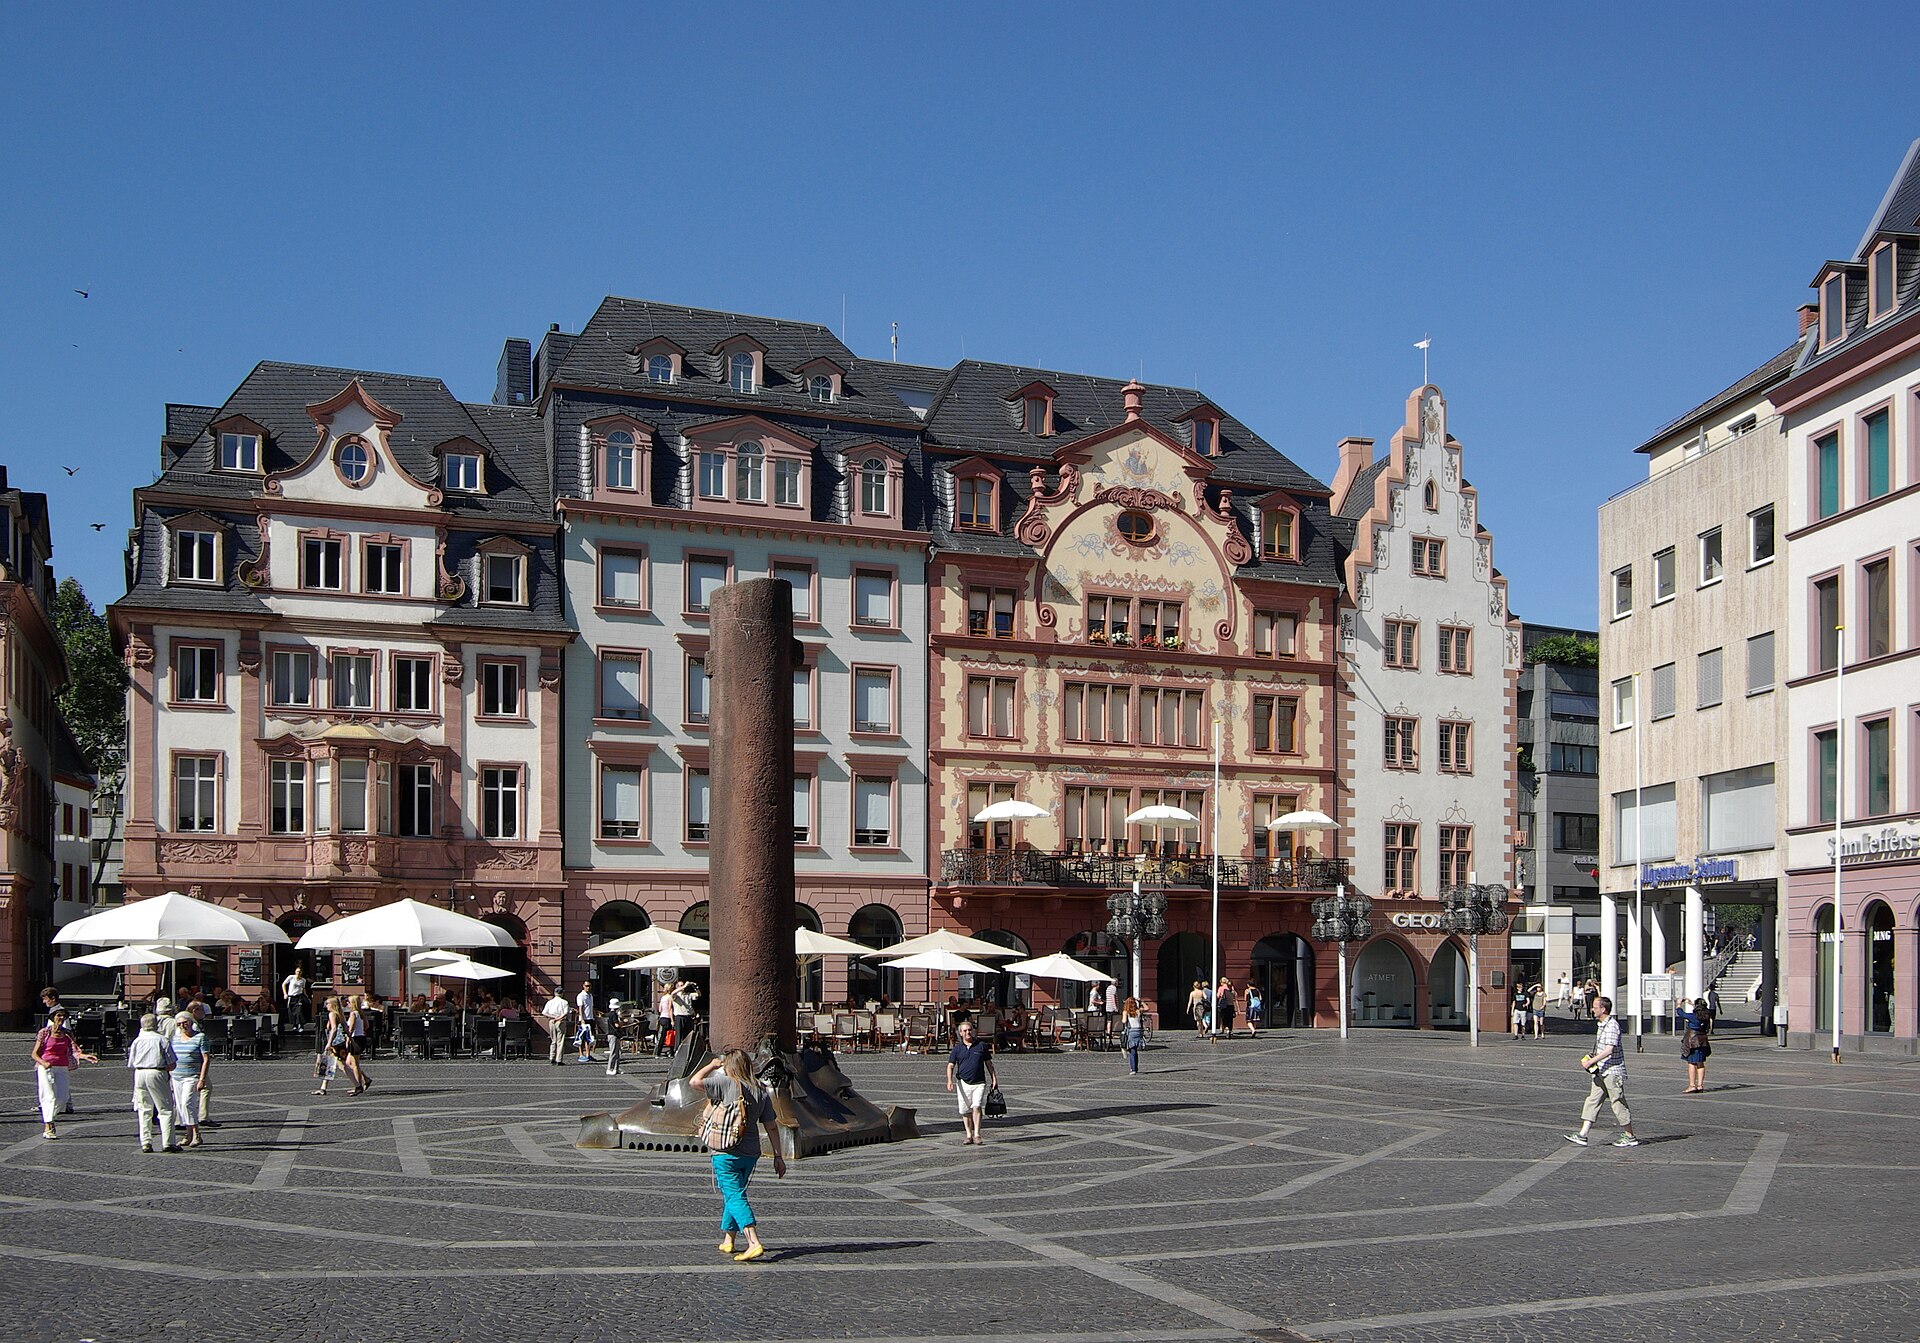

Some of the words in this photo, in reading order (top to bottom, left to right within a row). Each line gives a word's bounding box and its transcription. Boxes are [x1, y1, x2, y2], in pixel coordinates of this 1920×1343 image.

[1827, 827, 1914, 858] SnnLeffers
[1634, 863, 1692, 889] llgemeine
[1820, 932, 1845, 943] MANO
[1873, 930, 1891, 941] MNG
